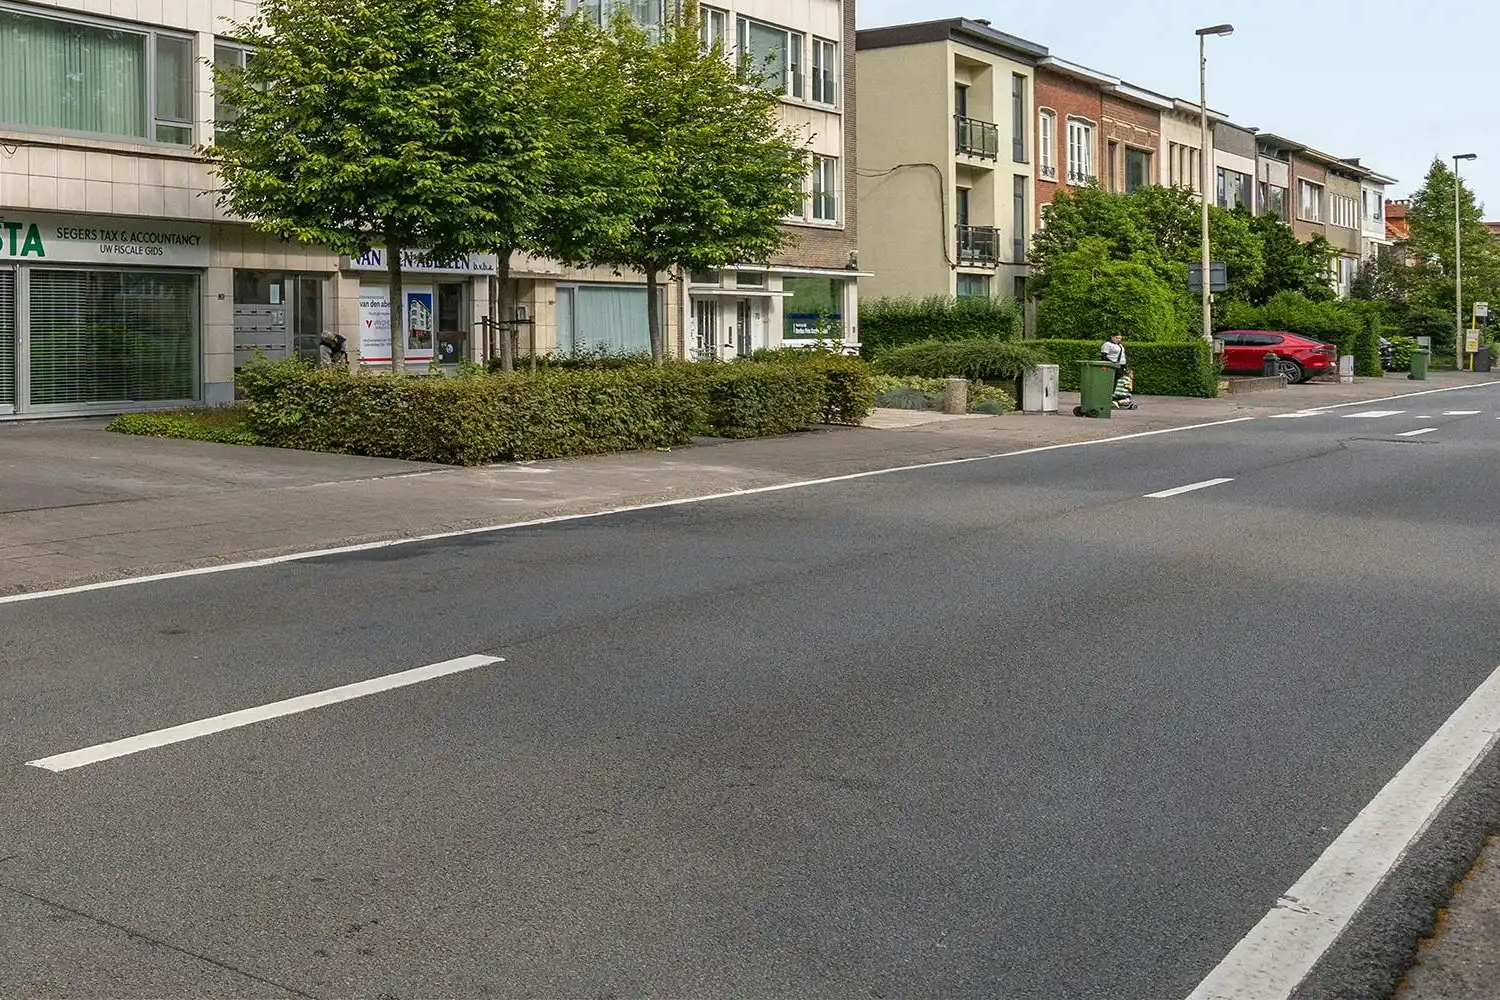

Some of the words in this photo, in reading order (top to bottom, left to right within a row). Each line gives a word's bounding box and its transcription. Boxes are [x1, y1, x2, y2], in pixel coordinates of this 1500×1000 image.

[56, 227, 97, 241] SEGERS
[100, 229, 118, 242] TAX
[120, 231, 128, 242] &
[129, 232, 201, 246] ACCOUNTANCY
[100, 244, 113, 255] UW
[114, 245, 144, 256] FISCALE
[146, 246, 164, 256] GIDS
